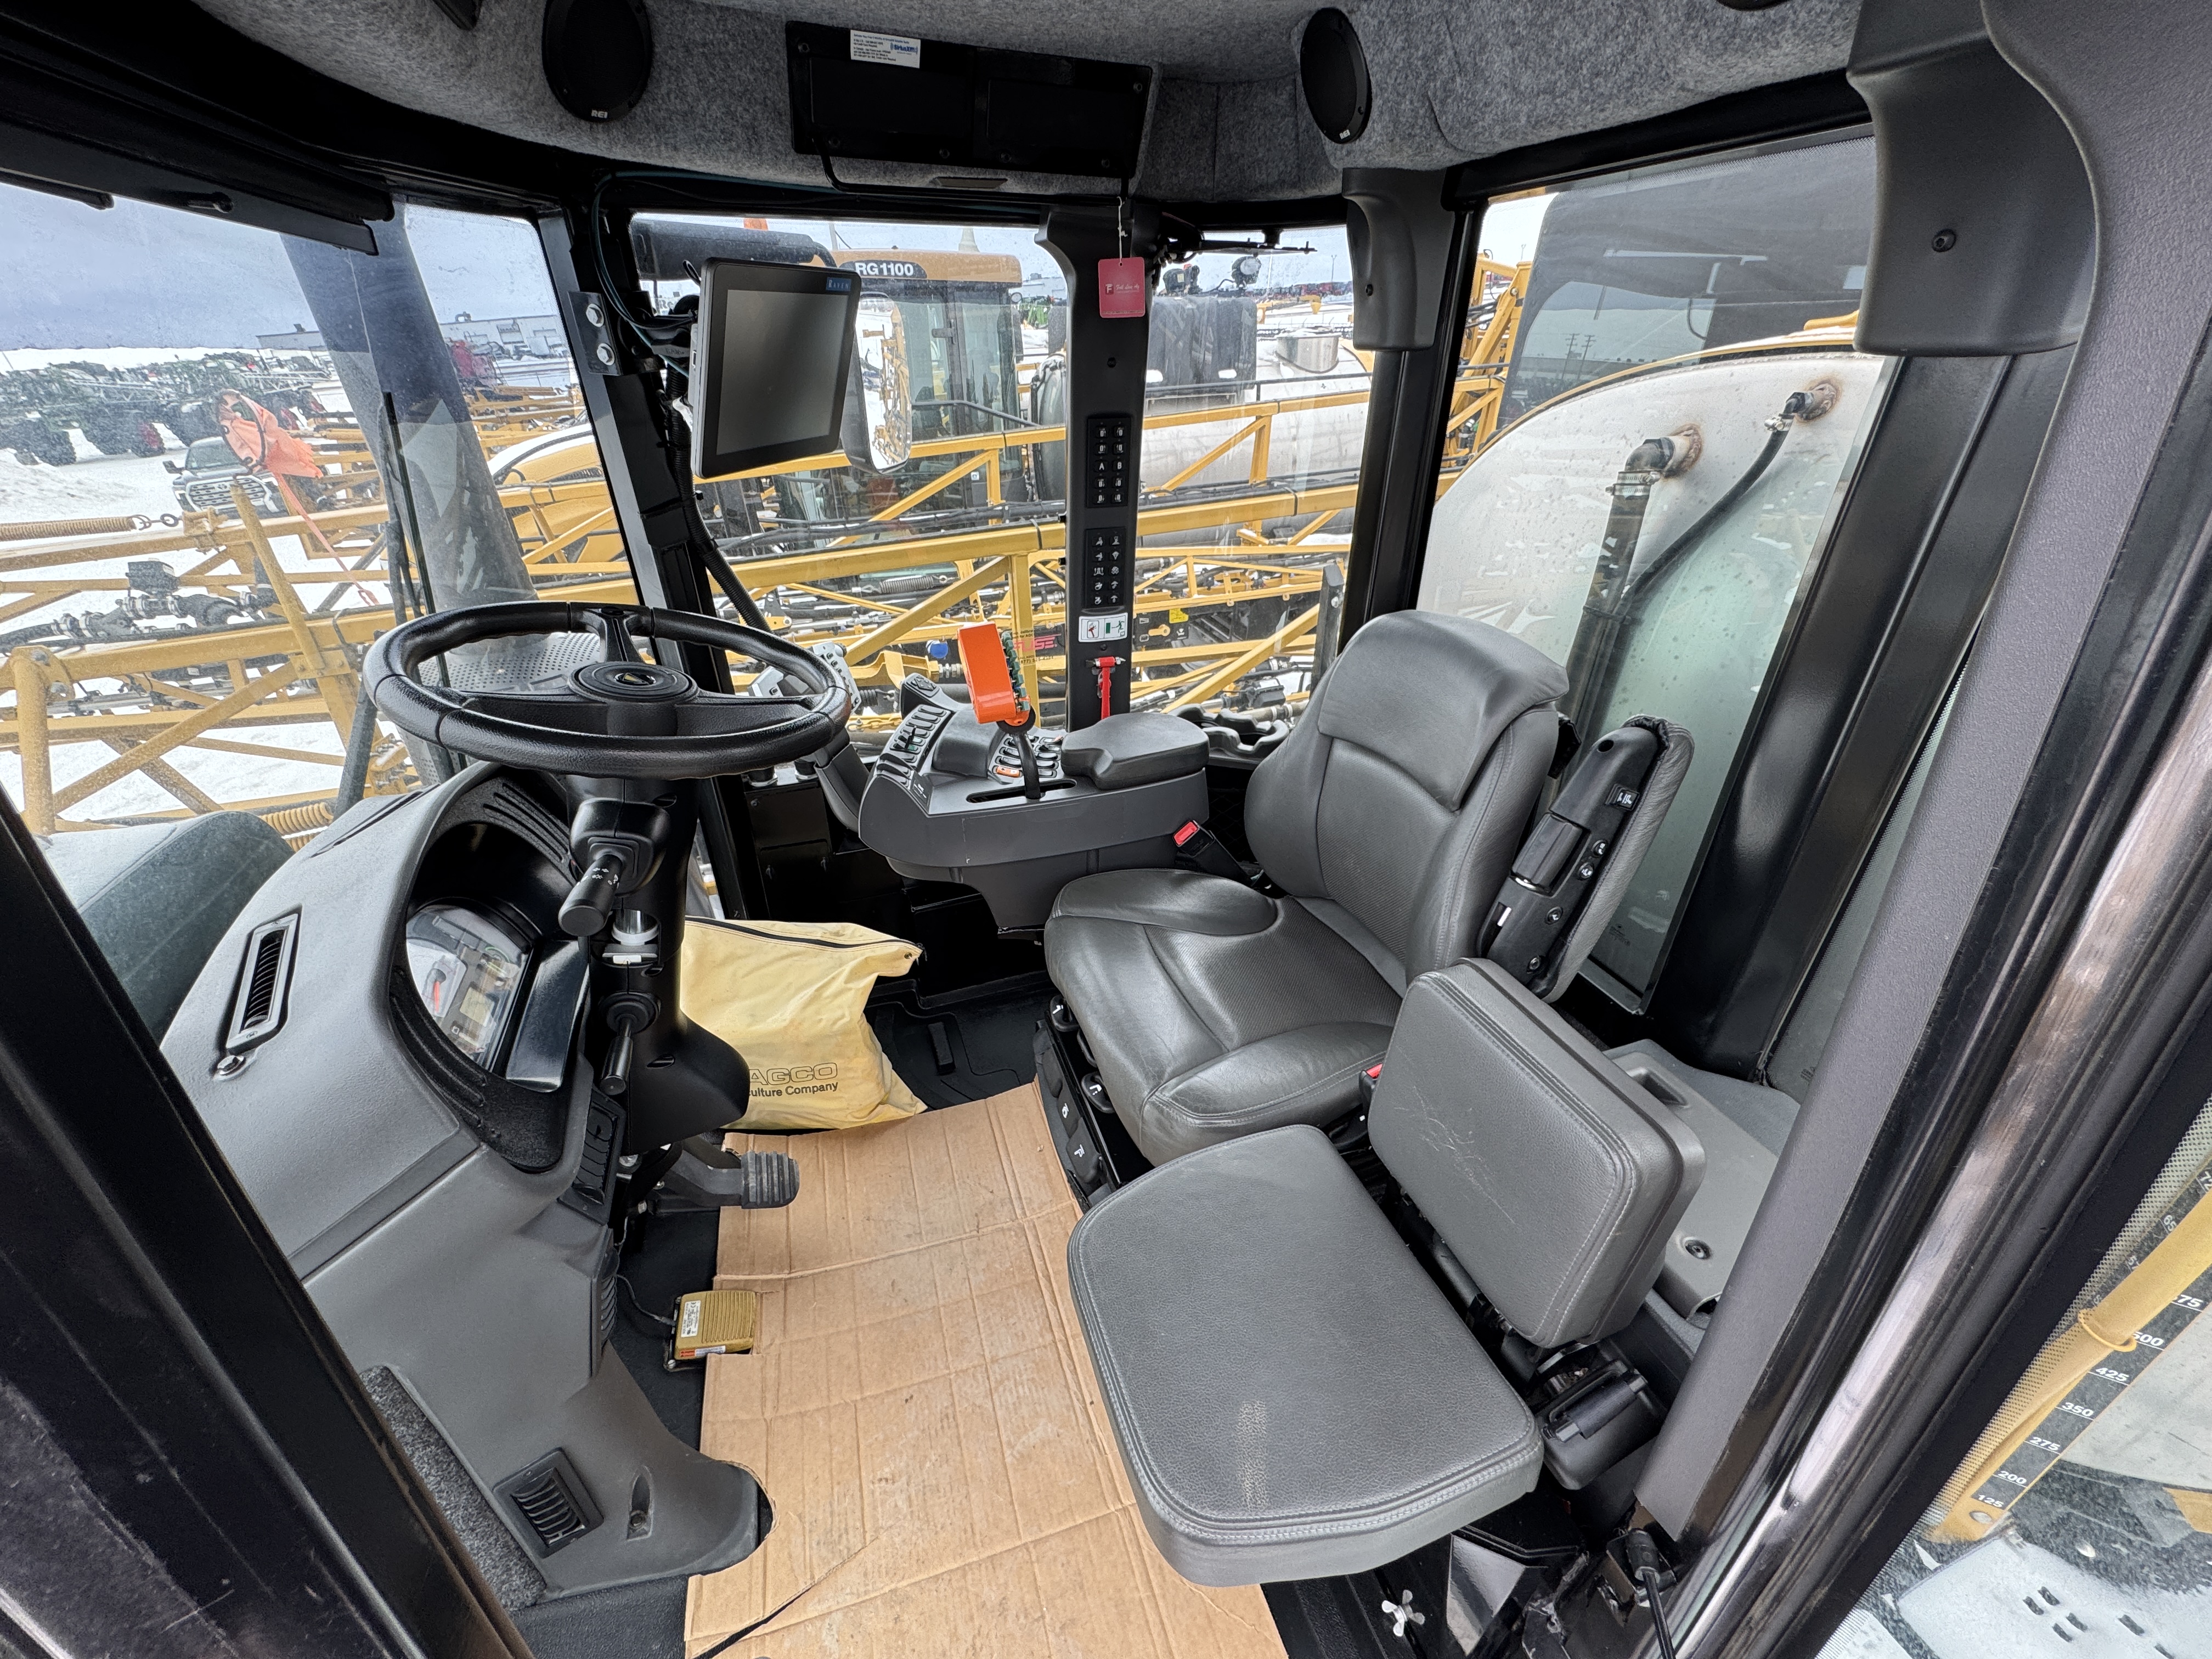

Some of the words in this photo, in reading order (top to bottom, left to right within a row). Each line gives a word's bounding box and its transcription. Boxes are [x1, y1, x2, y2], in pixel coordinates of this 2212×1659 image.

[591, 109, 608, 119] REI
[854, 262, 914, 276] RG1100
[828, 279, 849, 289] RAVEN
[1099, 462, 1105, 471] A
[1117, 461, 1122, 470] B
[749, 1062, 838, 1086] AGCO
[749, 1087, 783, 1097] ulture
[785, 1081, 838, 1096] Company
[2174, 1294, 2203, 1308] 75
[2132, 1331, 2165, 1347] 500
[2095, 1367, 2130, 1382] 425
[2062, 1402, 2095, 1417] 350
[2030, 1436, 2061, 1451] 275
[1997, 1470, 2027, 1485] 200
[1978, 1494, 2005, 1508] 125
